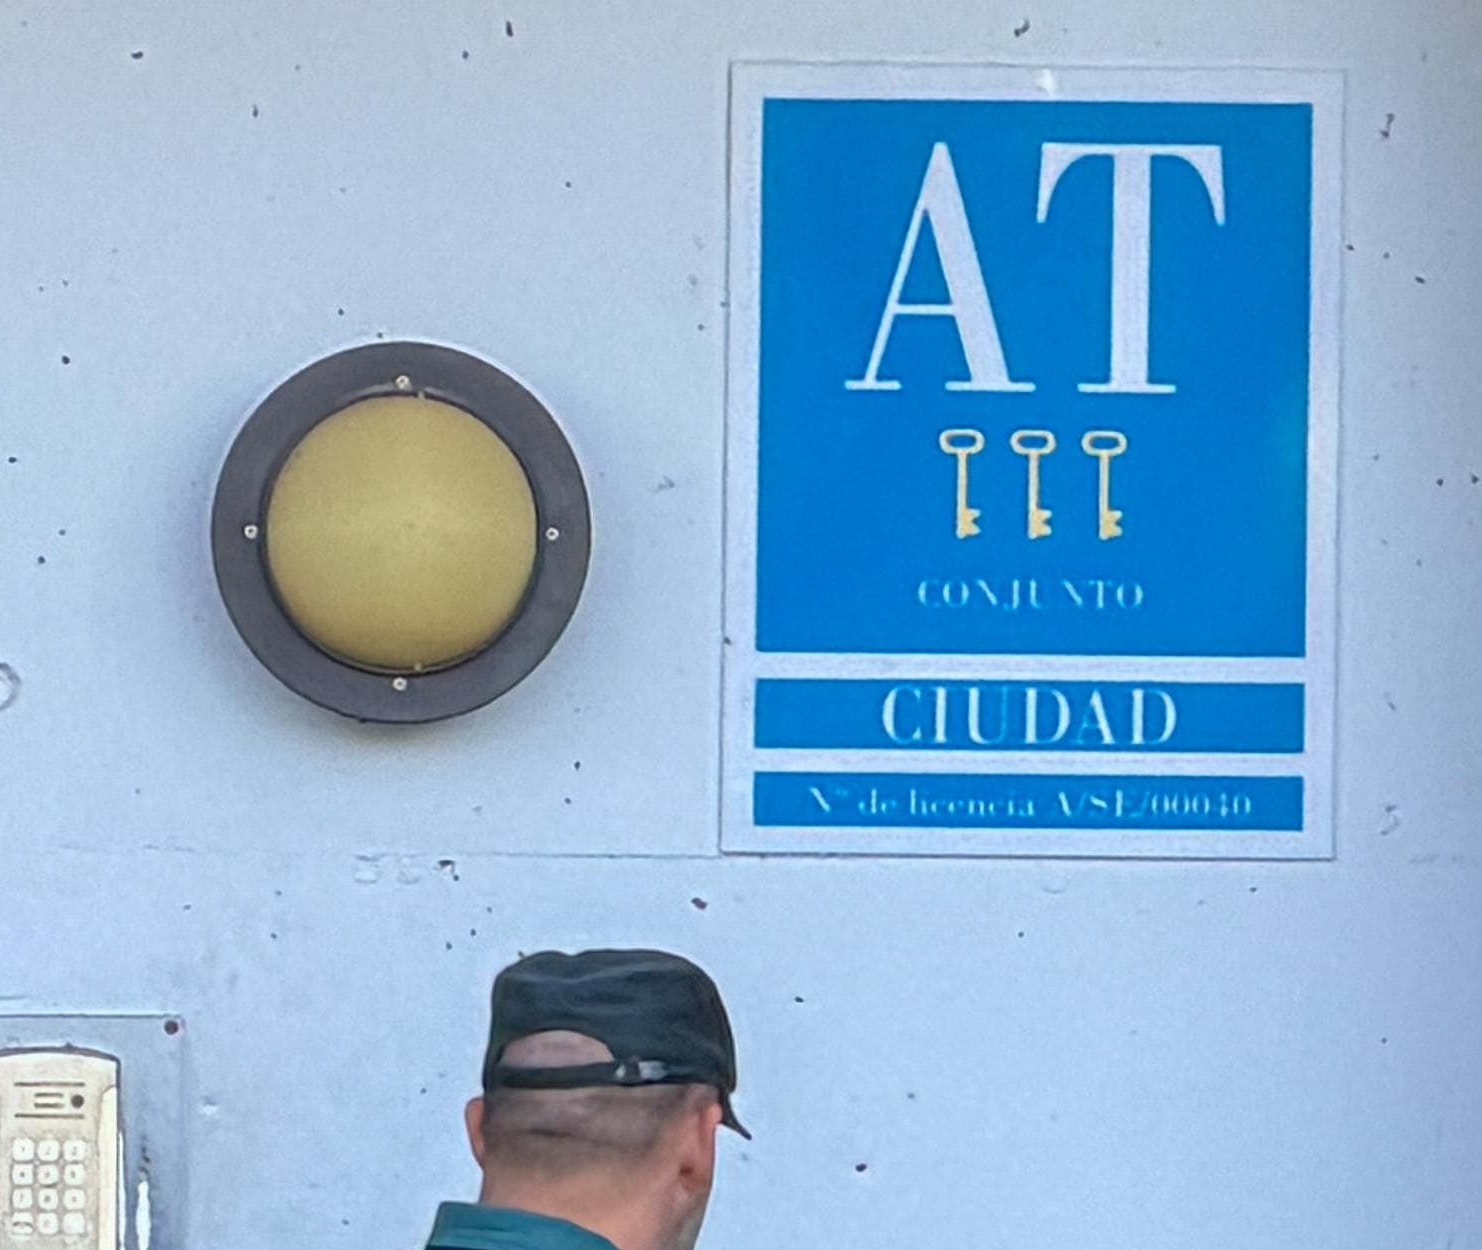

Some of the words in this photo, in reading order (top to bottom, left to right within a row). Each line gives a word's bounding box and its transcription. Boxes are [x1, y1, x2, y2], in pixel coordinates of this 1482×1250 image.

[844, 141, 1226, 394] AT
[917, 578, 1144, 610] CONJUNTO
[881, 684, 1178, 746] CIUDAD
[858, 788, 898, 815] de
[909, 788, 1035, 817] licencia
